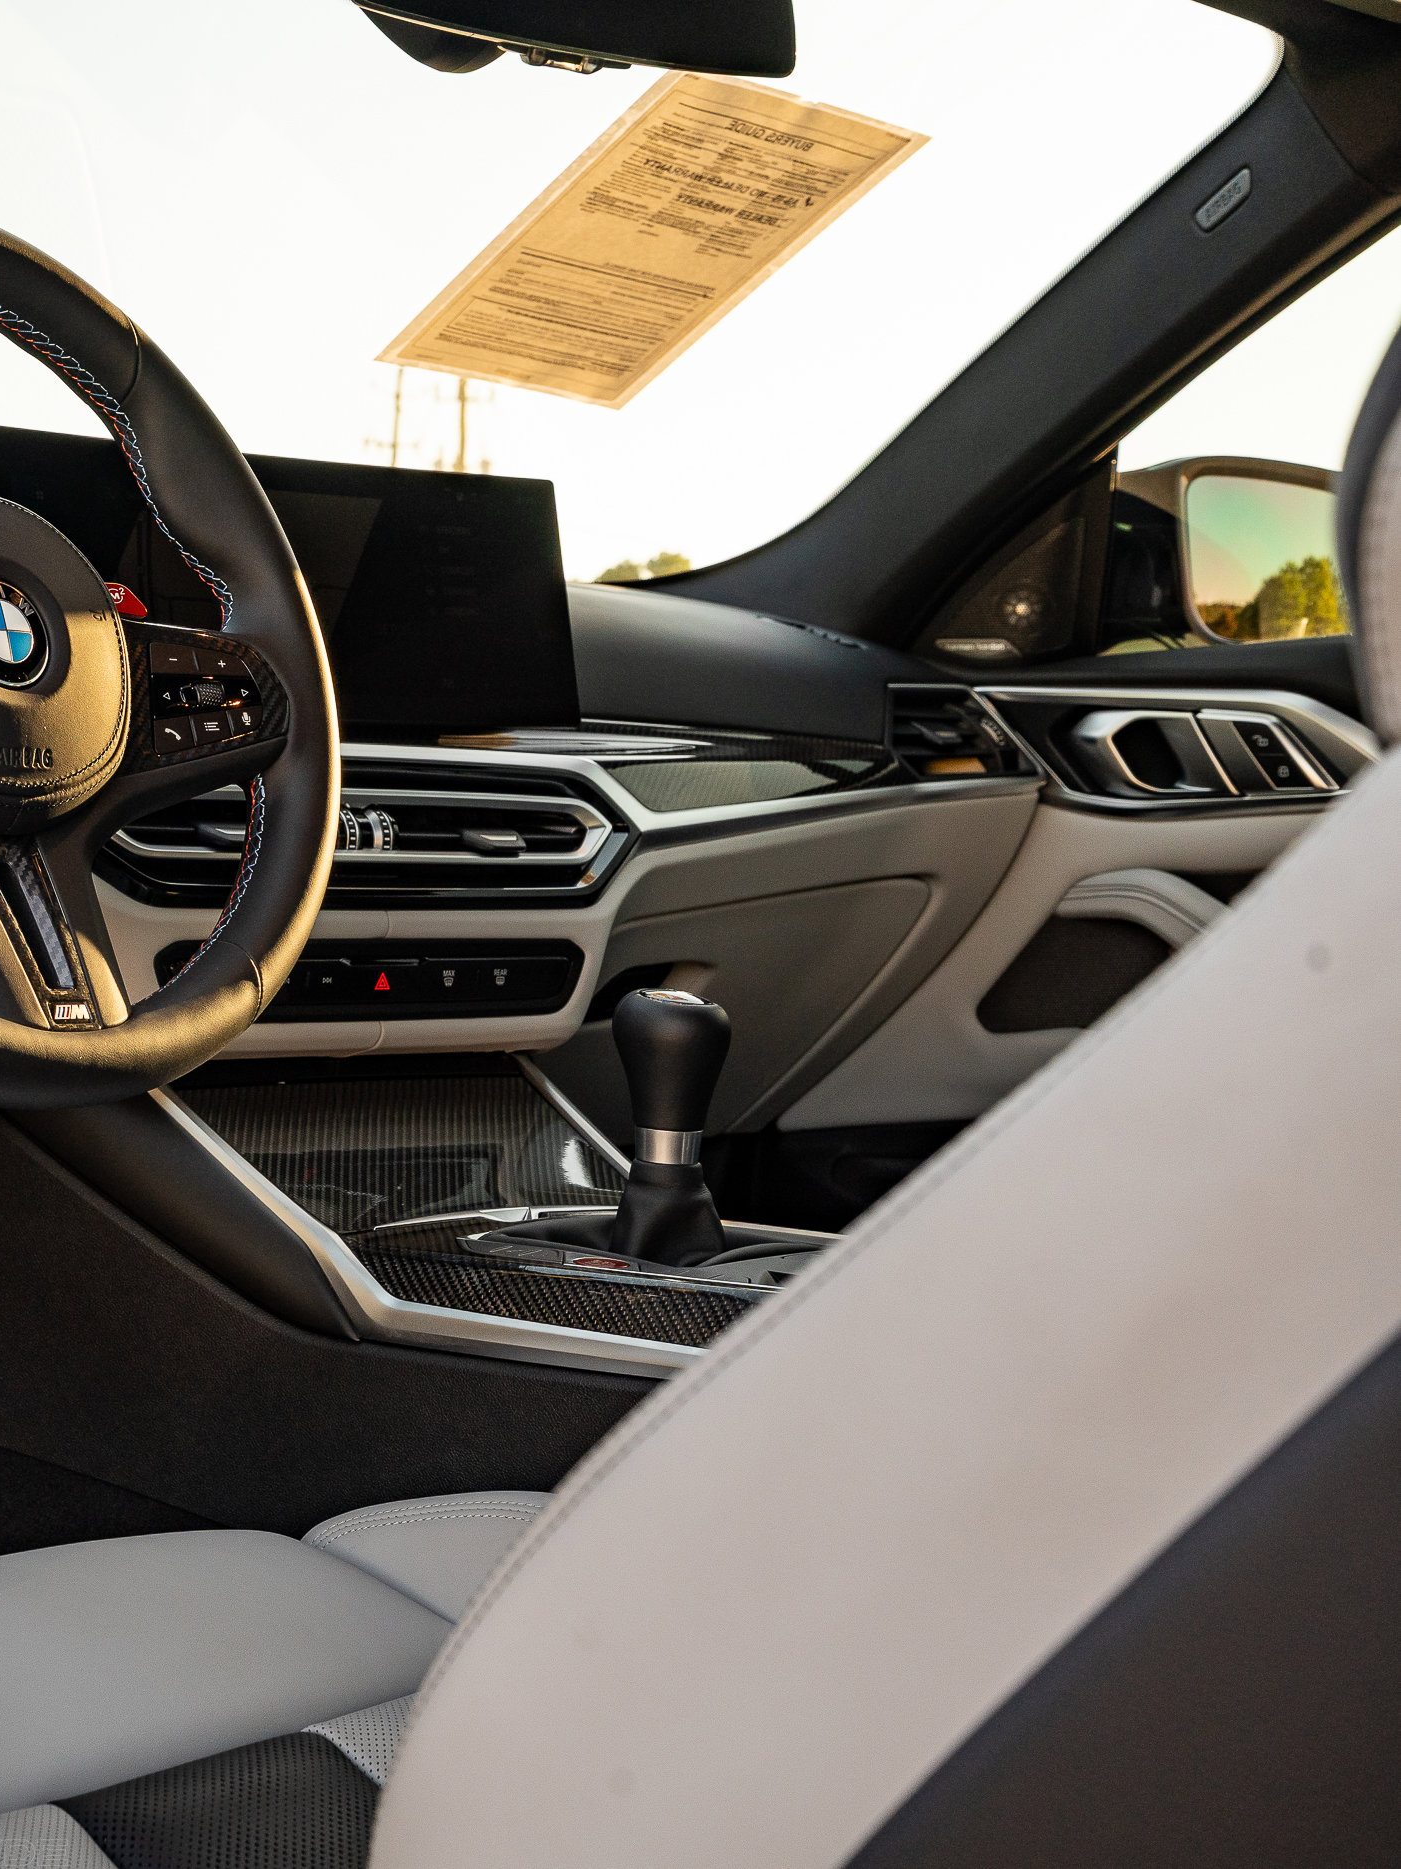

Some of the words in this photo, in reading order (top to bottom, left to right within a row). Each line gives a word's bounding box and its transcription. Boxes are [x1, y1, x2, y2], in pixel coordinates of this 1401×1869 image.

[0, 747, 54, 770] AIRBAG
[443, 969, 456, 977] MAX
[494, 968, 508, 976] REAR
